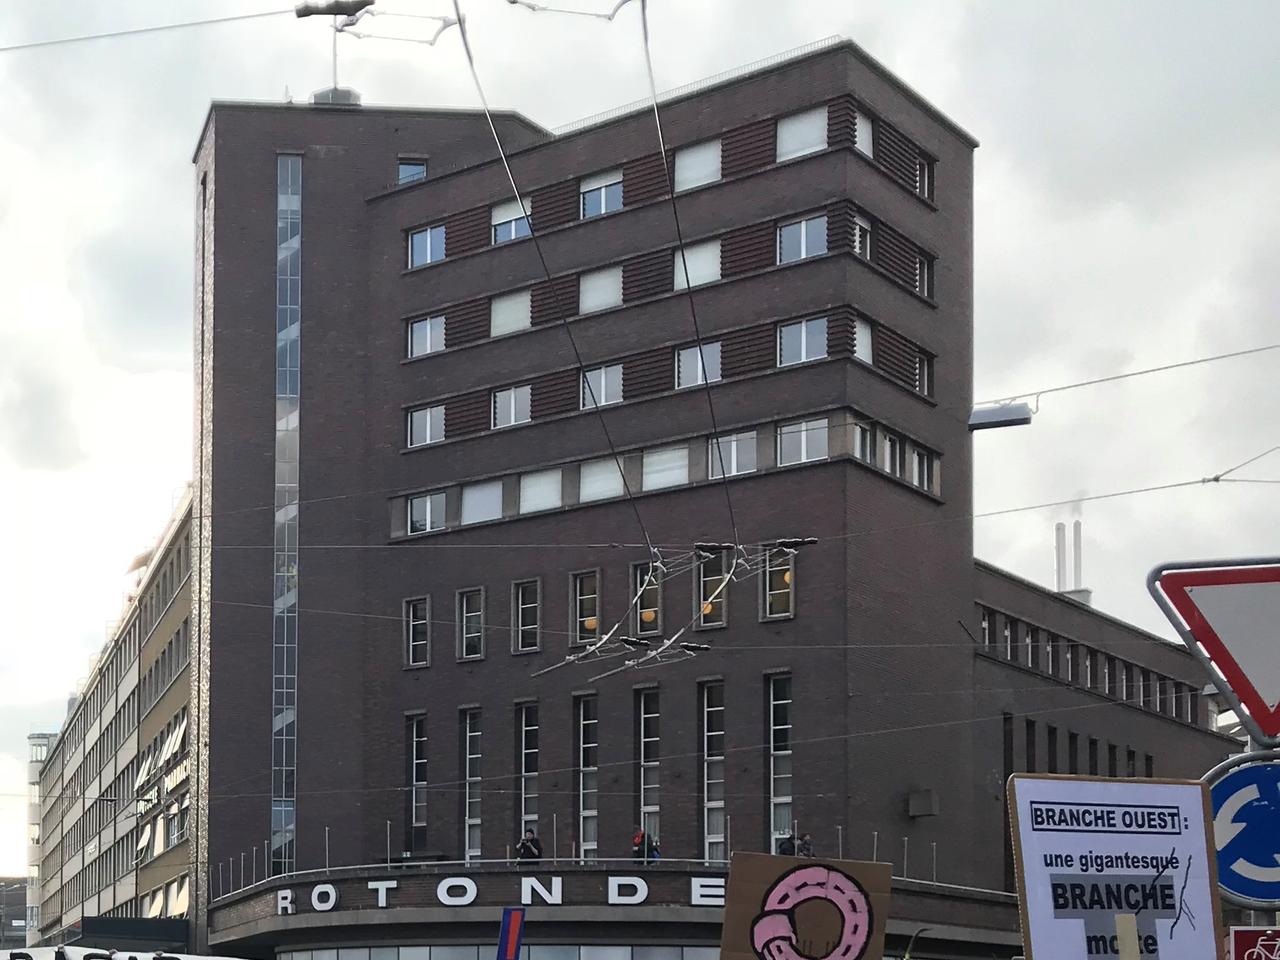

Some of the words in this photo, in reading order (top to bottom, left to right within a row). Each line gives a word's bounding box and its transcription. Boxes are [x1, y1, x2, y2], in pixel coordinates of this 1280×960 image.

[1033, 807, 1117, 828] BRANCHE
[1121, 810, 1179, 830] OUEST
[1043, 853, 1074, 868] une
[1079, 850, 1180, 873] gigantesque
[277, 876, 725, 916] ROTONDE
[1051, 882, 1176, 910] BRANCHE
[1087, 934, 1158, 955] mote
